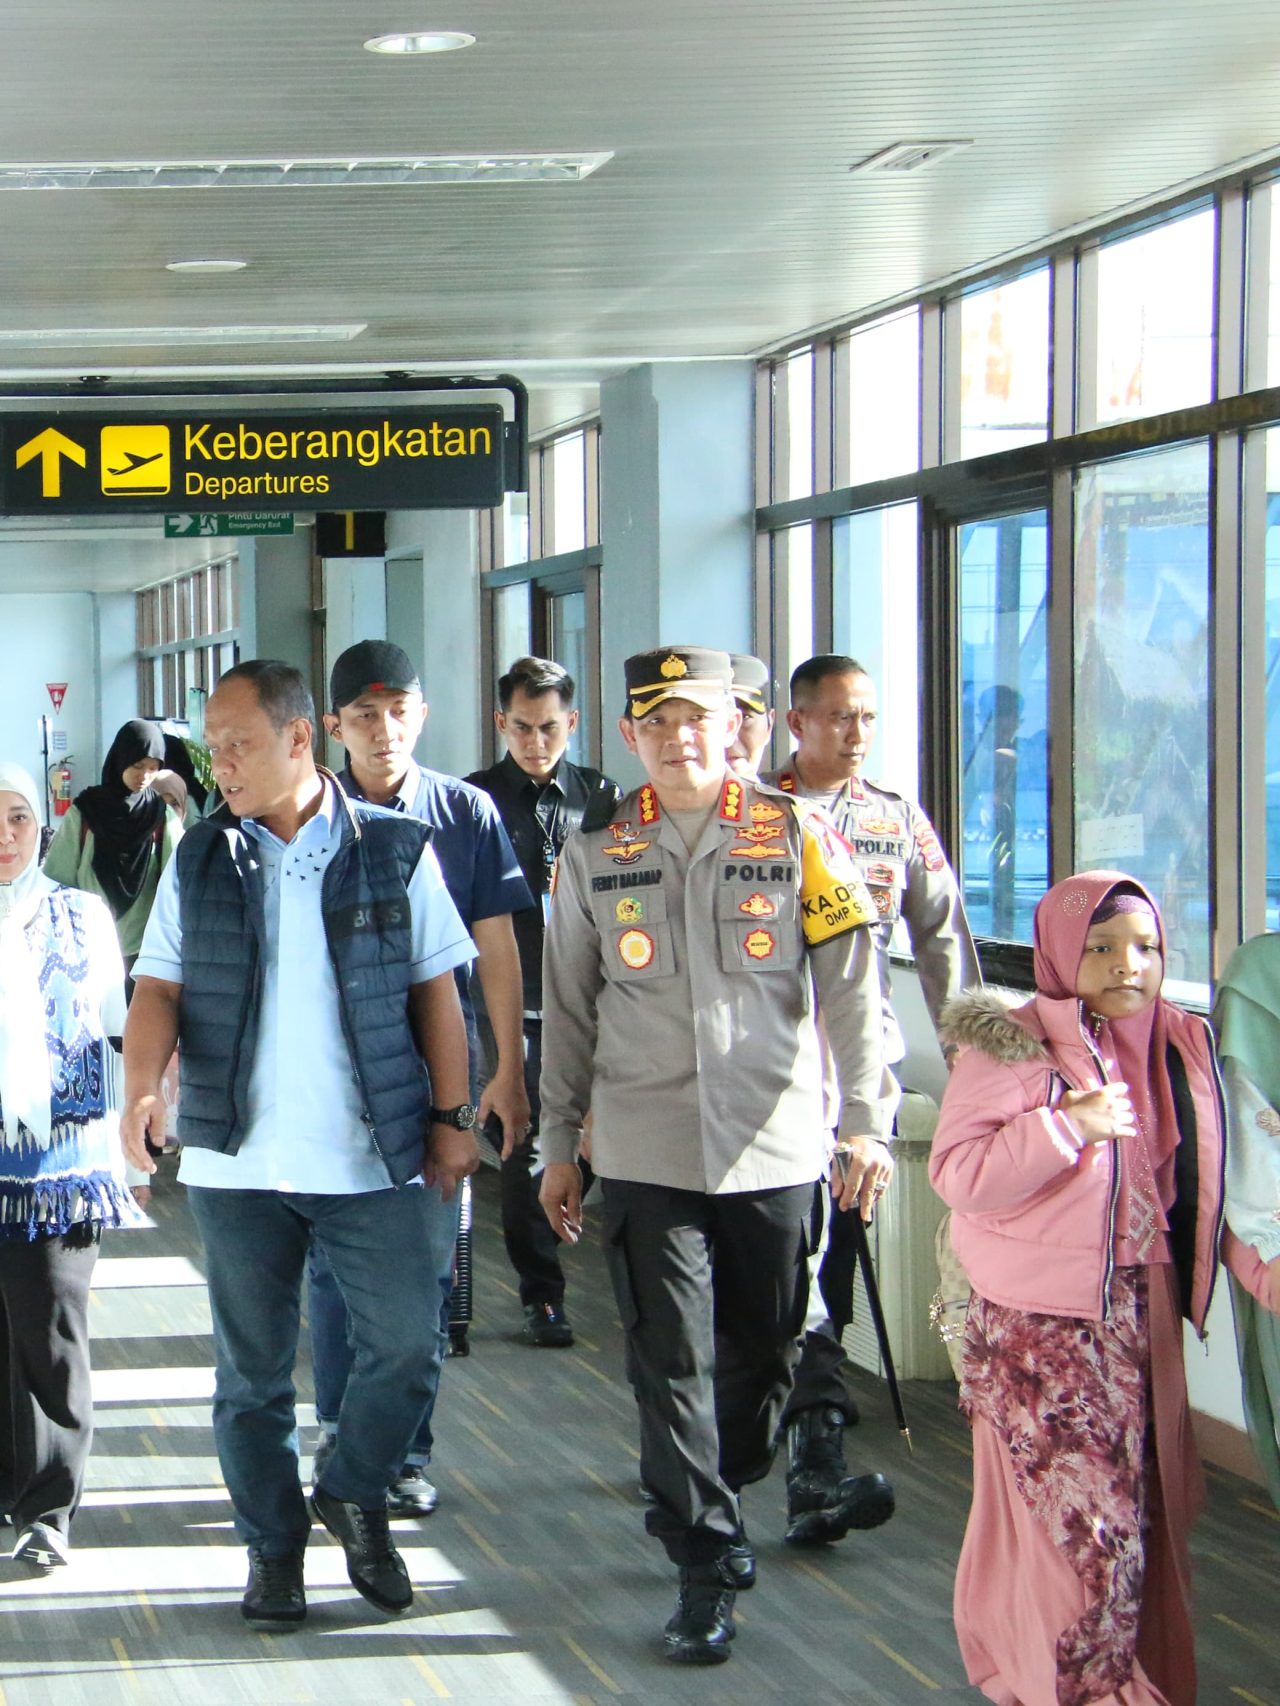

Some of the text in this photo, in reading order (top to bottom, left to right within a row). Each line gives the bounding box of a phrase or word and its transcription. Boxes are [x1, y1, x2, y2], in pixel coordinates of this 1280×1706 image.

[184, 421, 491, 466] Keberangkatan
[185, 472, 329, 499] Departures
[724, 864, 792, 883] POLRI
[801, 894, 833, 918] KA
[824, 906, 850, 927] OMP
